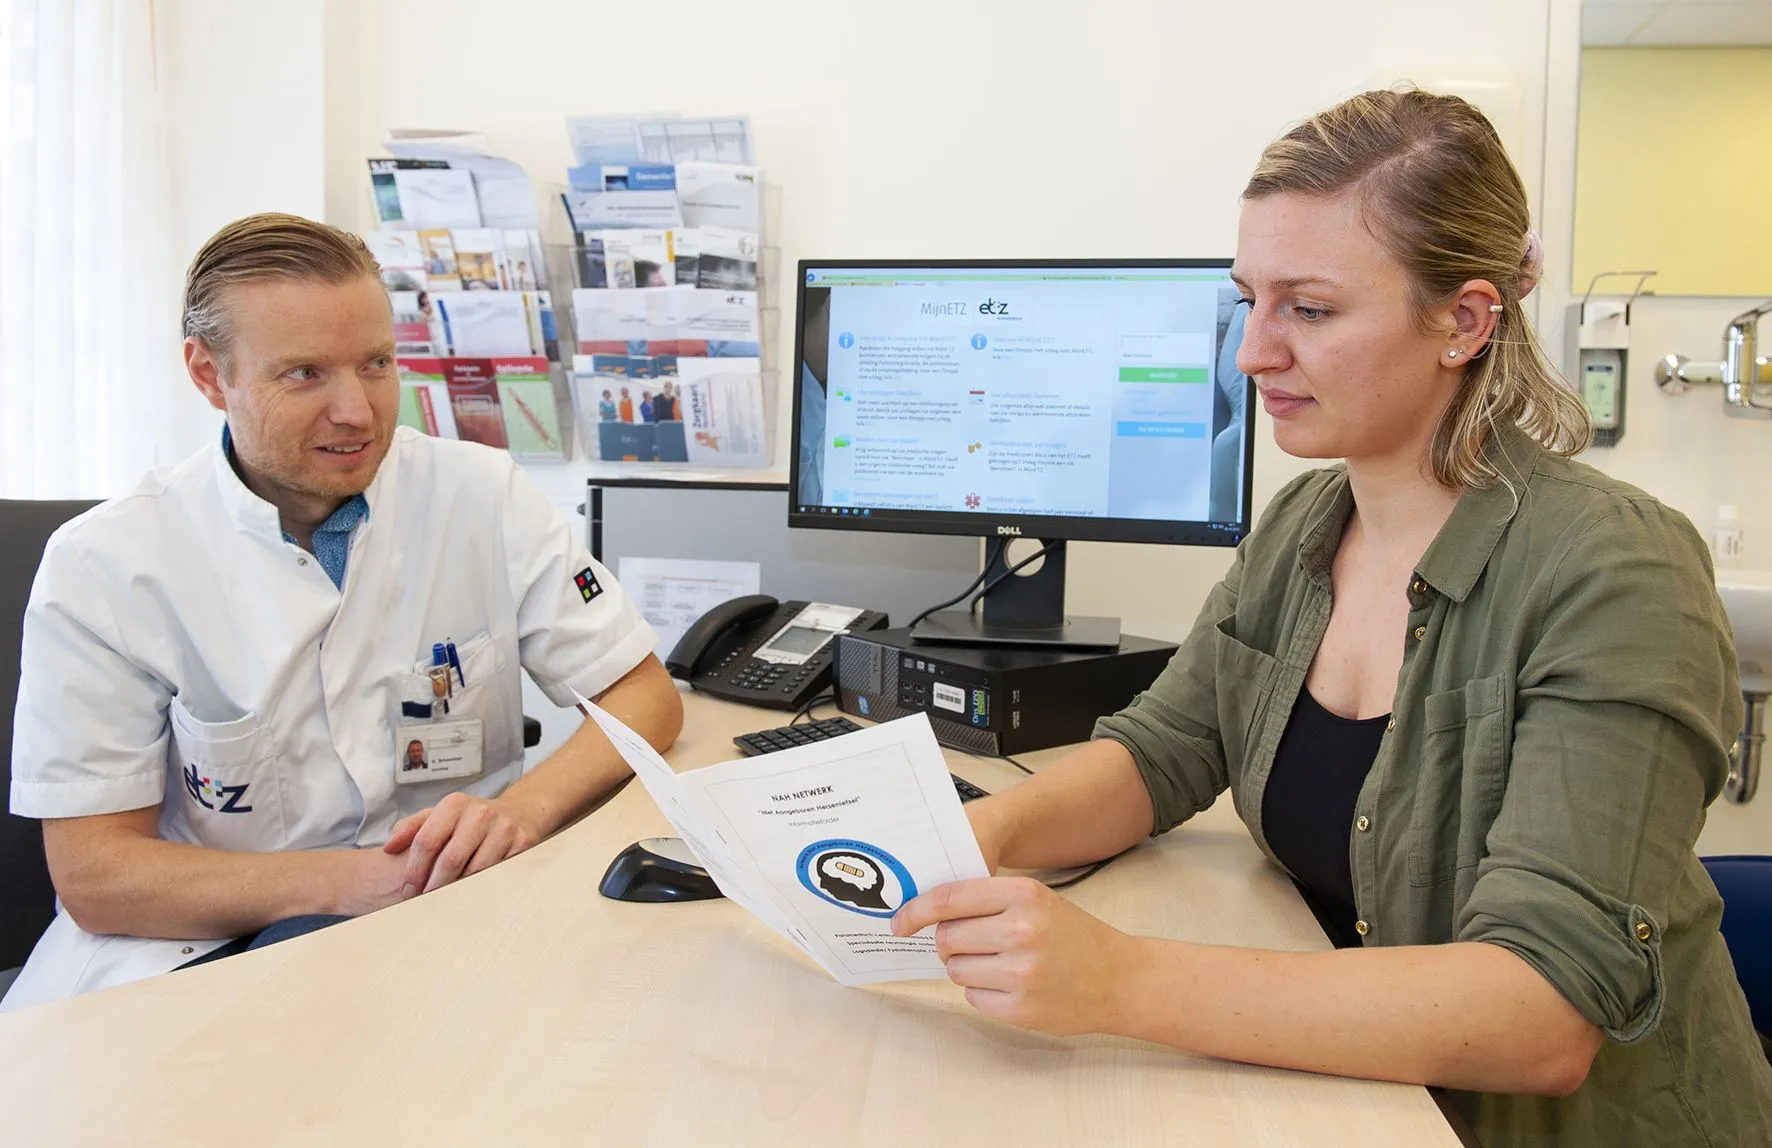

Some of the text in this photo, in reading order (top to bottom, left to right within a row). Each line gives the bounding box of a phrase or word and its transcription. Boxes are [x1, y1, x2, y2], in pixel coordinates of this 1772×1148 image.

[920, 302, 967, 318] MijnETZ
[998, 526, 1022, 535] DELL
[771, 785, 834, 802] NAH NETWERK
